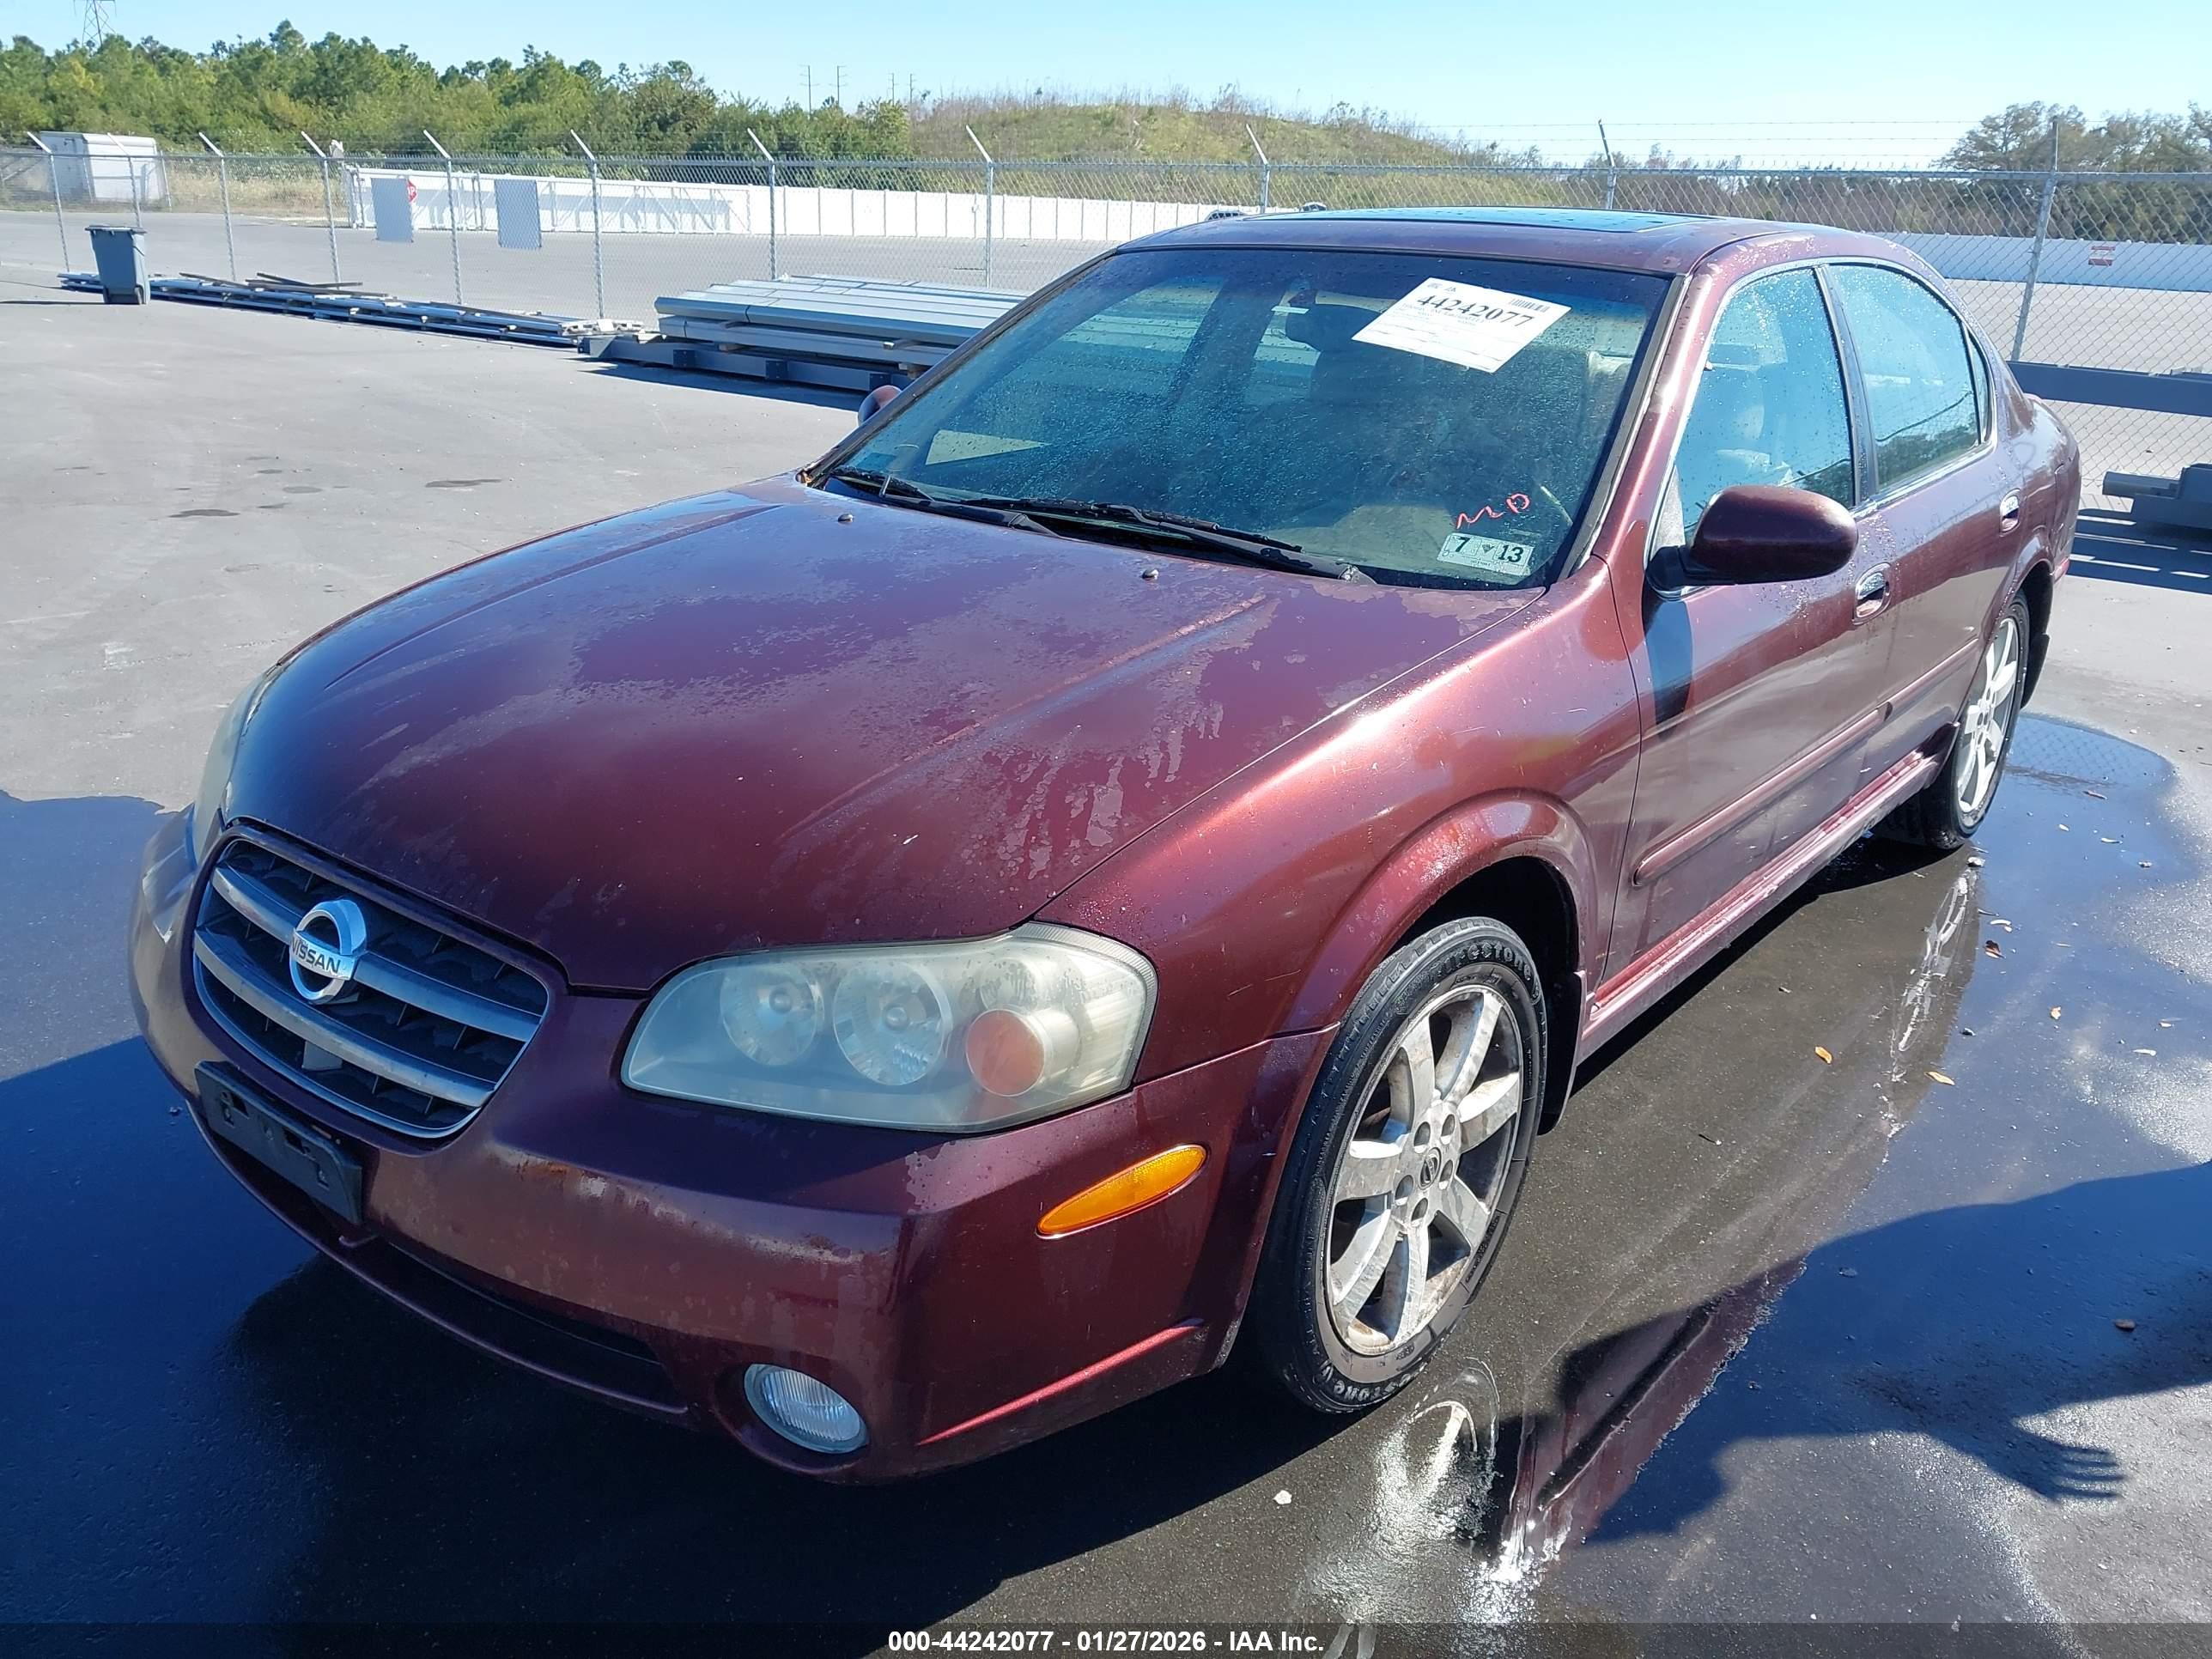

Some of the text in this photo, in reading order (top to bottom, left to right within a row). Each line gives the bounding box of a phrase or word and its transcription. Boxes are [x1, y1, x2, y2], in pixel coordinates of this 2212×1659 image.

[1416, 295, 1535, 327] 44242077
[1455, 536, 1471, 553] 7
[1498, 544, 1524, 563] 13
[292, 935, 342, 974] NISSAN
